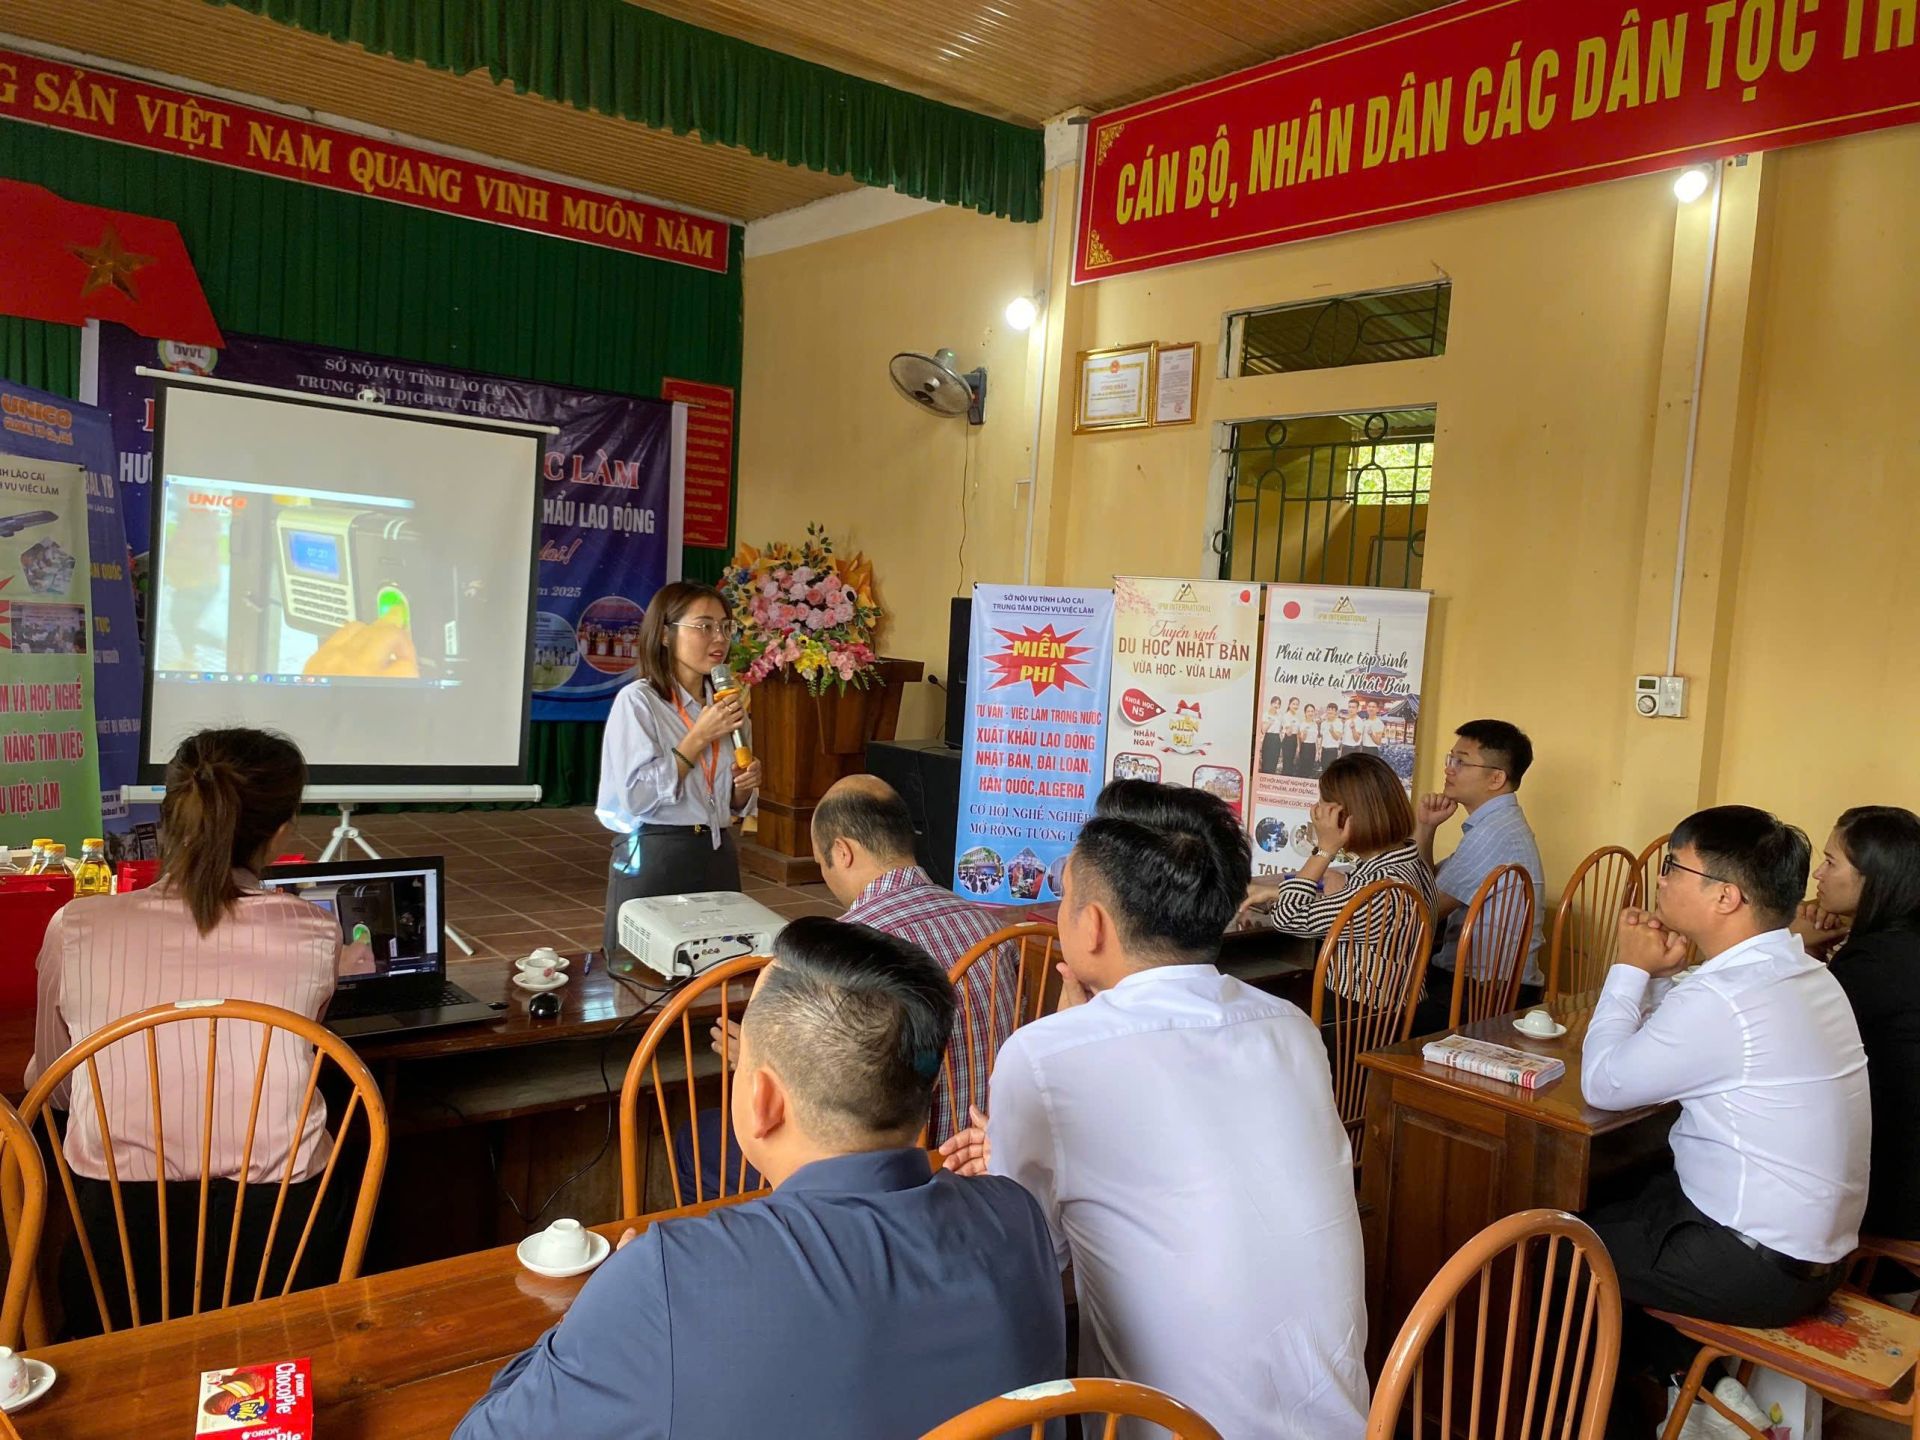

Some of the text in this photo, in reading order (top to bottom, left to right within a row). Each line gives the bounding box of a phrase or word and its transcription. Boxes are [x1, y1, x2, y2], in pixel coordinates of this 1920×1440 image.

[1116, 144, 1179, 225] CÁN
[1185, 124, 1238, 218] BỘ,
[1248, 97, 1355, 195] NHÂN
[1362, 72, 1453, 169] DÂN
[1463, 41, 1559, 146] CÁC
[1571, 8, 1689, 121] DÂN
[34, 70, 118, 125] SẢN
[136, 95, 230, 150] VIỆT
[248, 121, 332, 173] NAM
[349, 147, 461, 203] QUANG
[475, 175, 549, 221] VINH
[561, 196, 645, 243] MUÔN
[655, 217, 714, 258] NĂM
[325, 356, 347, 372] SỞ
[351, 361, 379, 380] NỘI
[384, 366, 405, 382] VỤ
[409, 369, 445, 388] TỈNH
[450, 376, 479, 392] LÀO
[297, 374, 354, 394] TRUNG
[396, 390, 436, 407] DỊCH
[1, 393, 73, 429] UNICO
[11, 469, 28, 479] LÀO
[31, 472, 46, 481] CAI
[120, 452, 153, 484] HƯ
[571, 448, 641, 490] LÀM
[19, 483, 39, 495] VIỆC
[41, 485, 59, 495] LÀM
[188, 492, 247, 509] UNICO
[541, 490, 655, 537] HẨU LAO ĐỘNG
[550, 585, 582, 598] 2025
[1004, 594, 1014, 602] SỞ
[1015, 594, 1027, 602] NỘI
[1028, 595, 1038, 603] VỤ
[1039, 595, 1056, 604] TỈNH
[1057, 596, 1071, 604] LÀO
[993, 603, 1094, 615] TRUNG TÂM DỊCH VỤ VIỆC LÀM
[1150, 619, 1218, 646] Tuyển sinh
[1013, 633, 1066, 659] MIỄN
[1119, 637, 1250, 662] DU HỌC NHẬT BẢN
[1275, 643, 1408, 673] Phái cử Thực tập sinh
[1020, 662, 1057, 683] PHÍ
[1133, 659, 1152, 675] VỪA
[1156, 663, 1176, 679] HỌC
[1186, 663, 1206, 679] VỪA
[1209, 665, 1231, 680] LÀM
[1274, 666, 1411, 695] làm việc tại Nhật Bản
[12, 680, 27, 712] VÀ
[30, 683, 51, 717] HỌC
[1131, 706, 1145, 717] N5
[1011, 704, 1029, 723] VIỆC
[1031, 705, 1048, 722] LÀM
[1051, 709, 1077, 725] TRONG
[4, 729, 35, 763] NĂNG
[38, 727, 57, 760] TÌM
[60, 726, 84, 765] VIỆC
[976, 723, 1095, 753] XUẤT KHẨU LAO ĐỘNG
[1133, 739, 1155, 747] NGAY
[976, 748, 1091, 775] NHẬT BẢN, ĐÀI LOAN,
[979, 773, 1002, 792] HÀN
[9, 777, 60, 818] VIỆC LÀM
[970, 803, 986, 815] CƠ
[989, 803, 1009, 819] HỘI
[970, 820, 987, 834] MỞ
[990, 822, 1022, 839] RỘNG
[1026, 826, 1066, 841] TƯƠNG
[276, 1363, 297, 1414] ChocoPie
[251, 1427, 281, 1438] ORION
